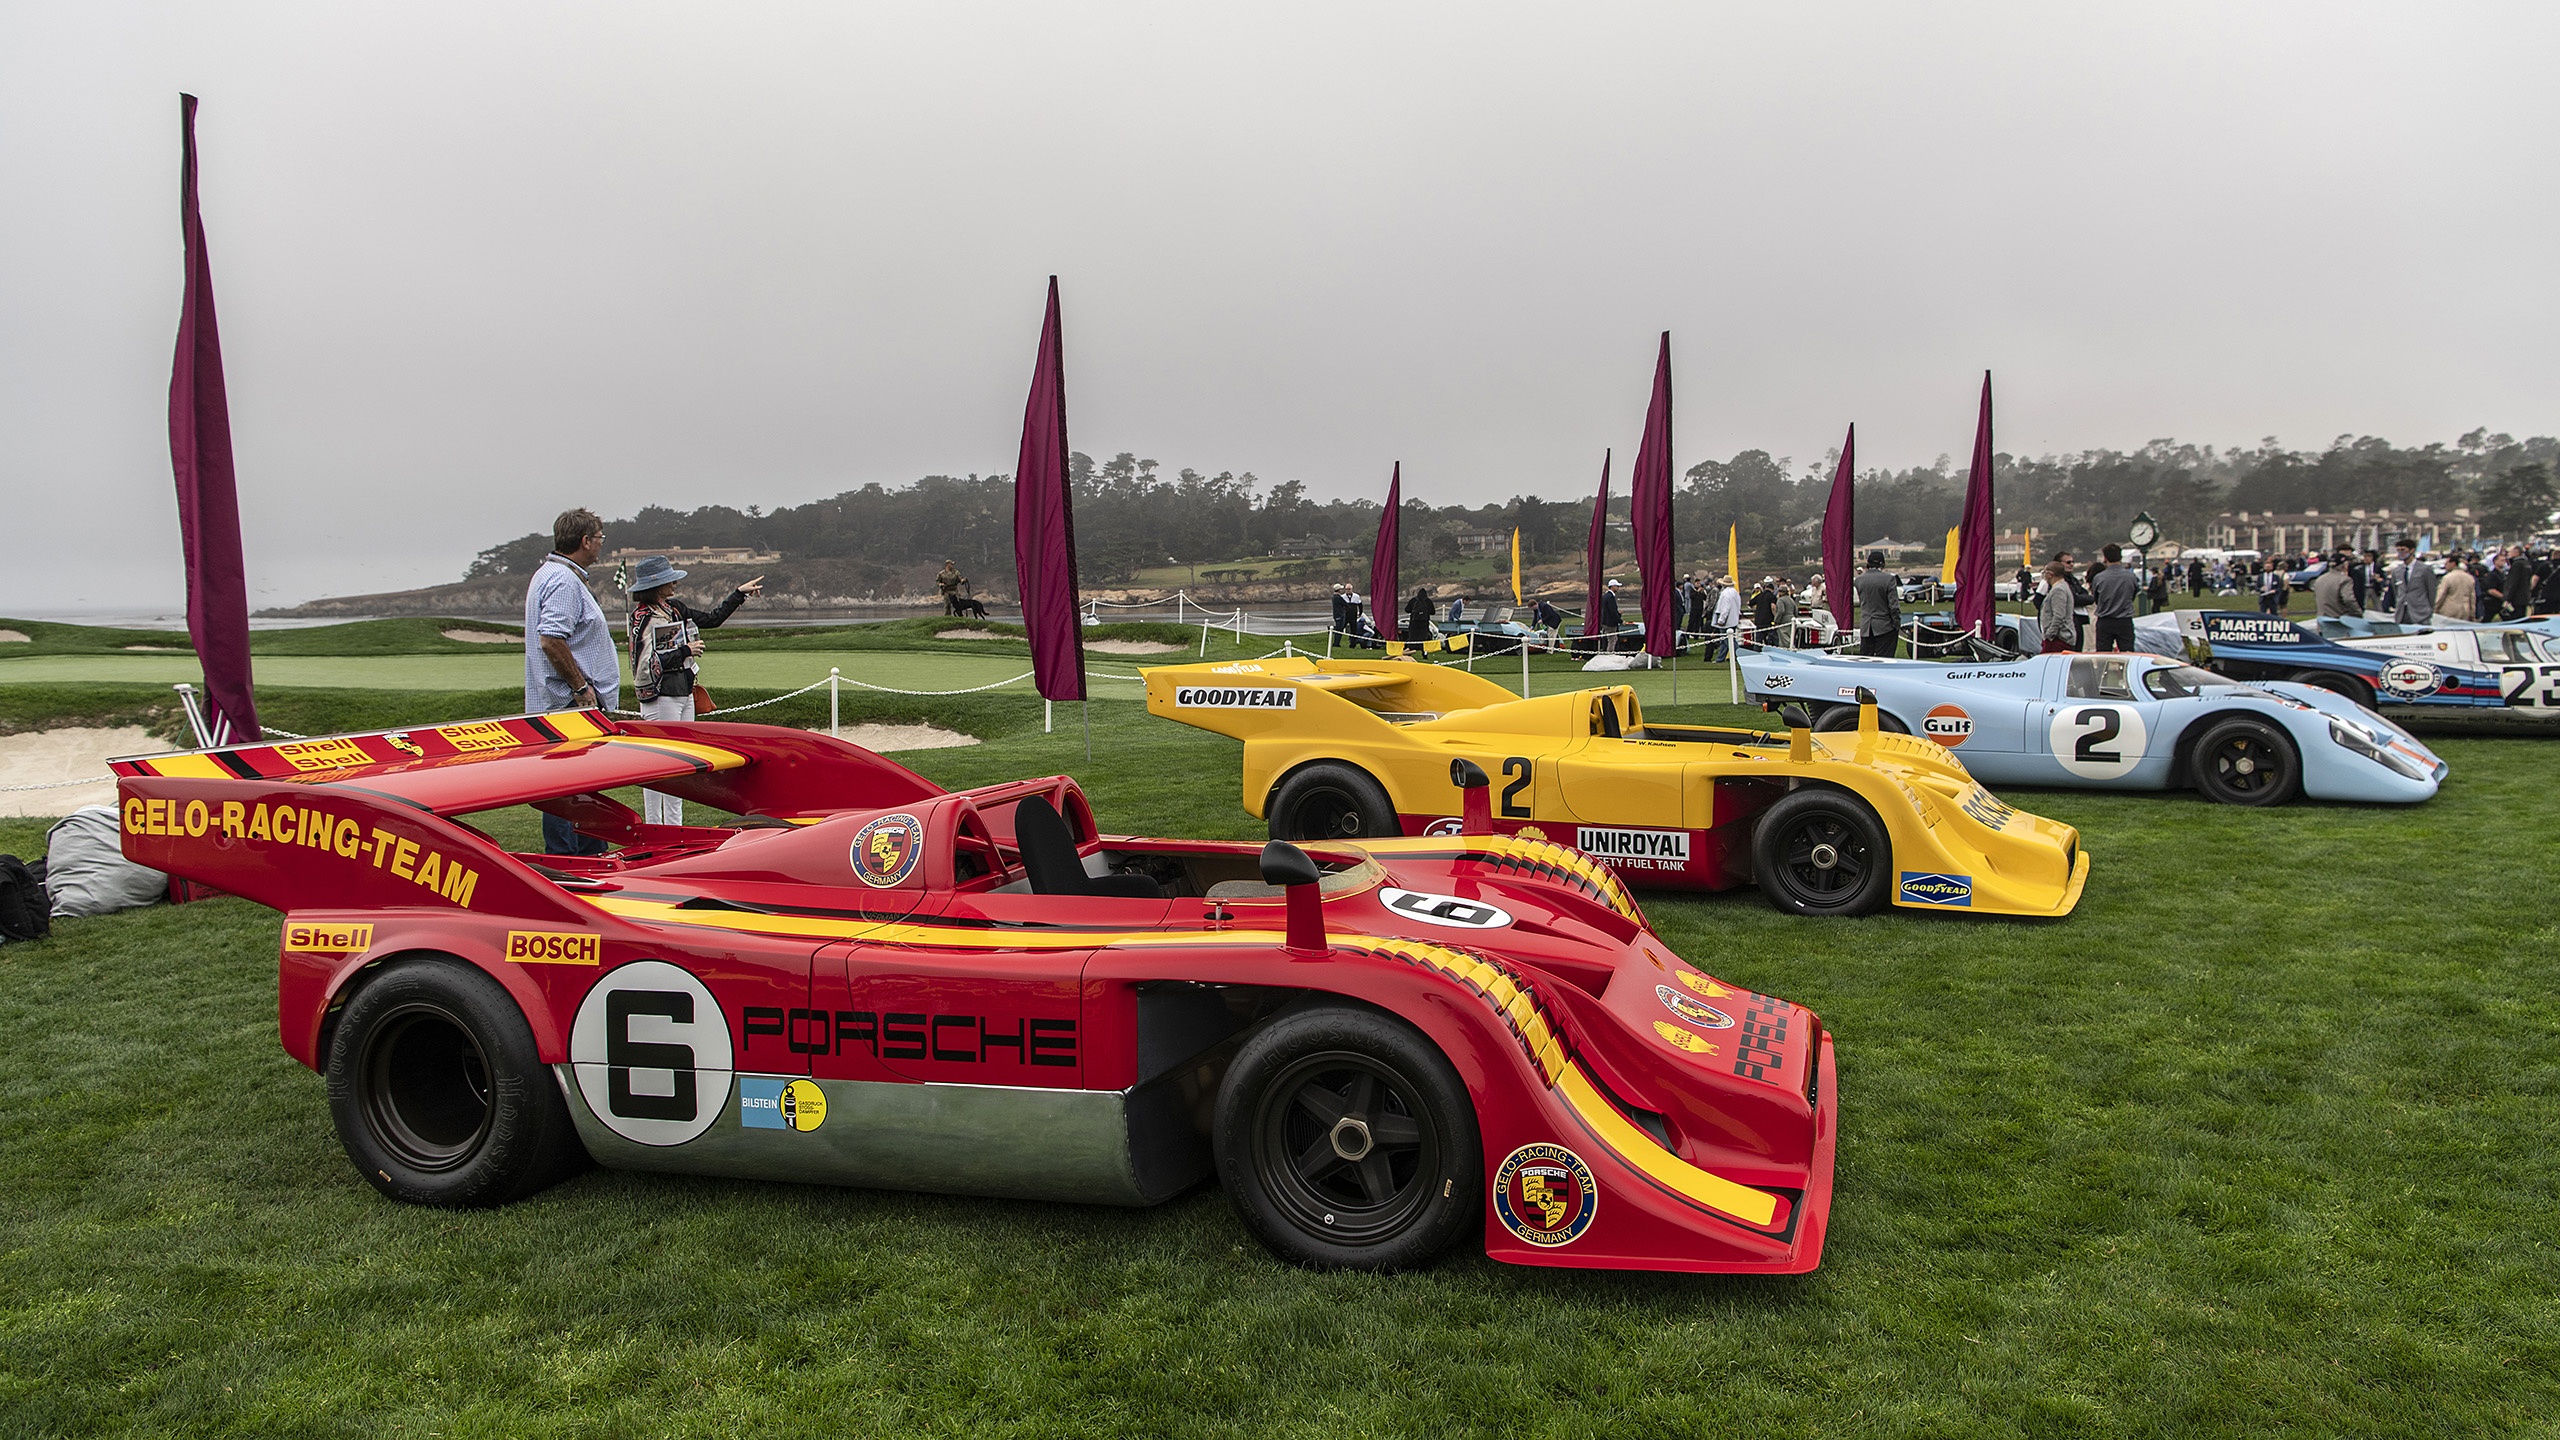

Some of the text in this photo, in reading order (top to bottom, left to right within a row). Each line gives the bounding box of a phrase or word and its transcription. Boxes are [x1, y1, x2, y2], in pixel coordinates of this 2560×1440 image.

[2220, 620, 2290, 632] MARTINI
[2209, 631, 2300, 643] RACING-TEAM
[1946, 671, 2027, 680] Gulf-Porsche
[1178, 689, 1294, 707] GOODYEAR
[441, 722, 501, 739] Shell
[1923, 718, 1973, 734] Gulf
[455, 735, 516, 749] Shell
[2074, 708, 2122, 764] 2
[278, 739, 351, 756] Shell
[293, 752, 368, 769] Shell
[1501, 756, 1532, 819] 2
[125, 797, 480, 908] GELO-RACING-TEAM
[1580, 830, 1686, 858] UNIROYAL
[1626, 858, 1655, 870] FUEL
[1656, 860, 1686, 872] TANK
[1903, 883, 1969, 895] GOODYEAR
[1391, 893, 1501, 926] 6
[290, 928, 368, 947] Shell
[511, 936, 597, 961] BOSCH
[743, 1006, 1077, 1067] PORSCHE
[605, 989, 698, 1122] 6
[742, 1097, 778, 1109] BILSTEIN
[1496, 1146, 1594, 1195] GELO-RACING-TEAM
[1520, 1168, 1568, 1179] PORSCHE
[1516, 1224, 1574, 1244] GERMANY
